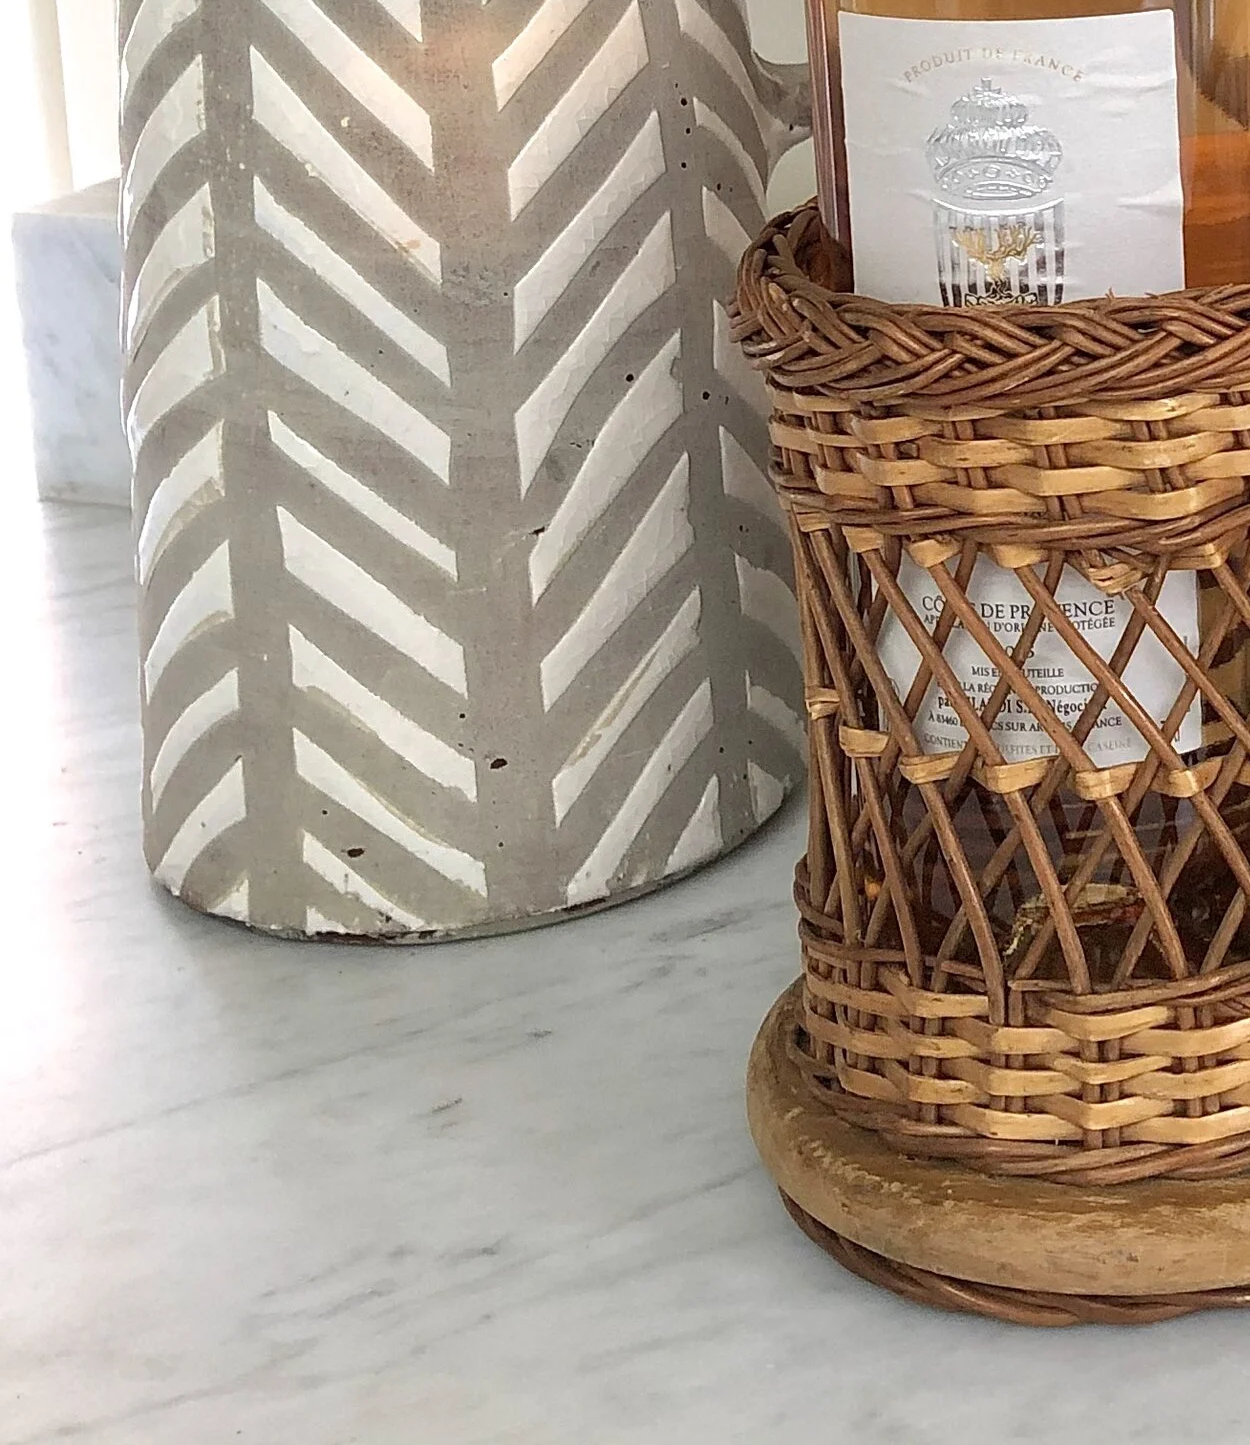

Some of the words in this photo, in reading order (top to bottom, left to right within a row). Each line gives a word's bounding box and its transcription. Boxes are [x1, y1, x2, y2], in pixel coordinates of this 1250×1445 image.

[903, 47, 973, 83] PRODUIT
[981, 47, 1004, 60] DE
[1012, 48, 1088, 83] FRANCE
[981, 603, 1005, 619] DE
[1009, 599, 1116, 619] PRENCE
[971, 666, 990, 677] MIS
[1034, 682, 1099, 695] PRODUCTIO
[1004, 721, 1027, 732] SUR
